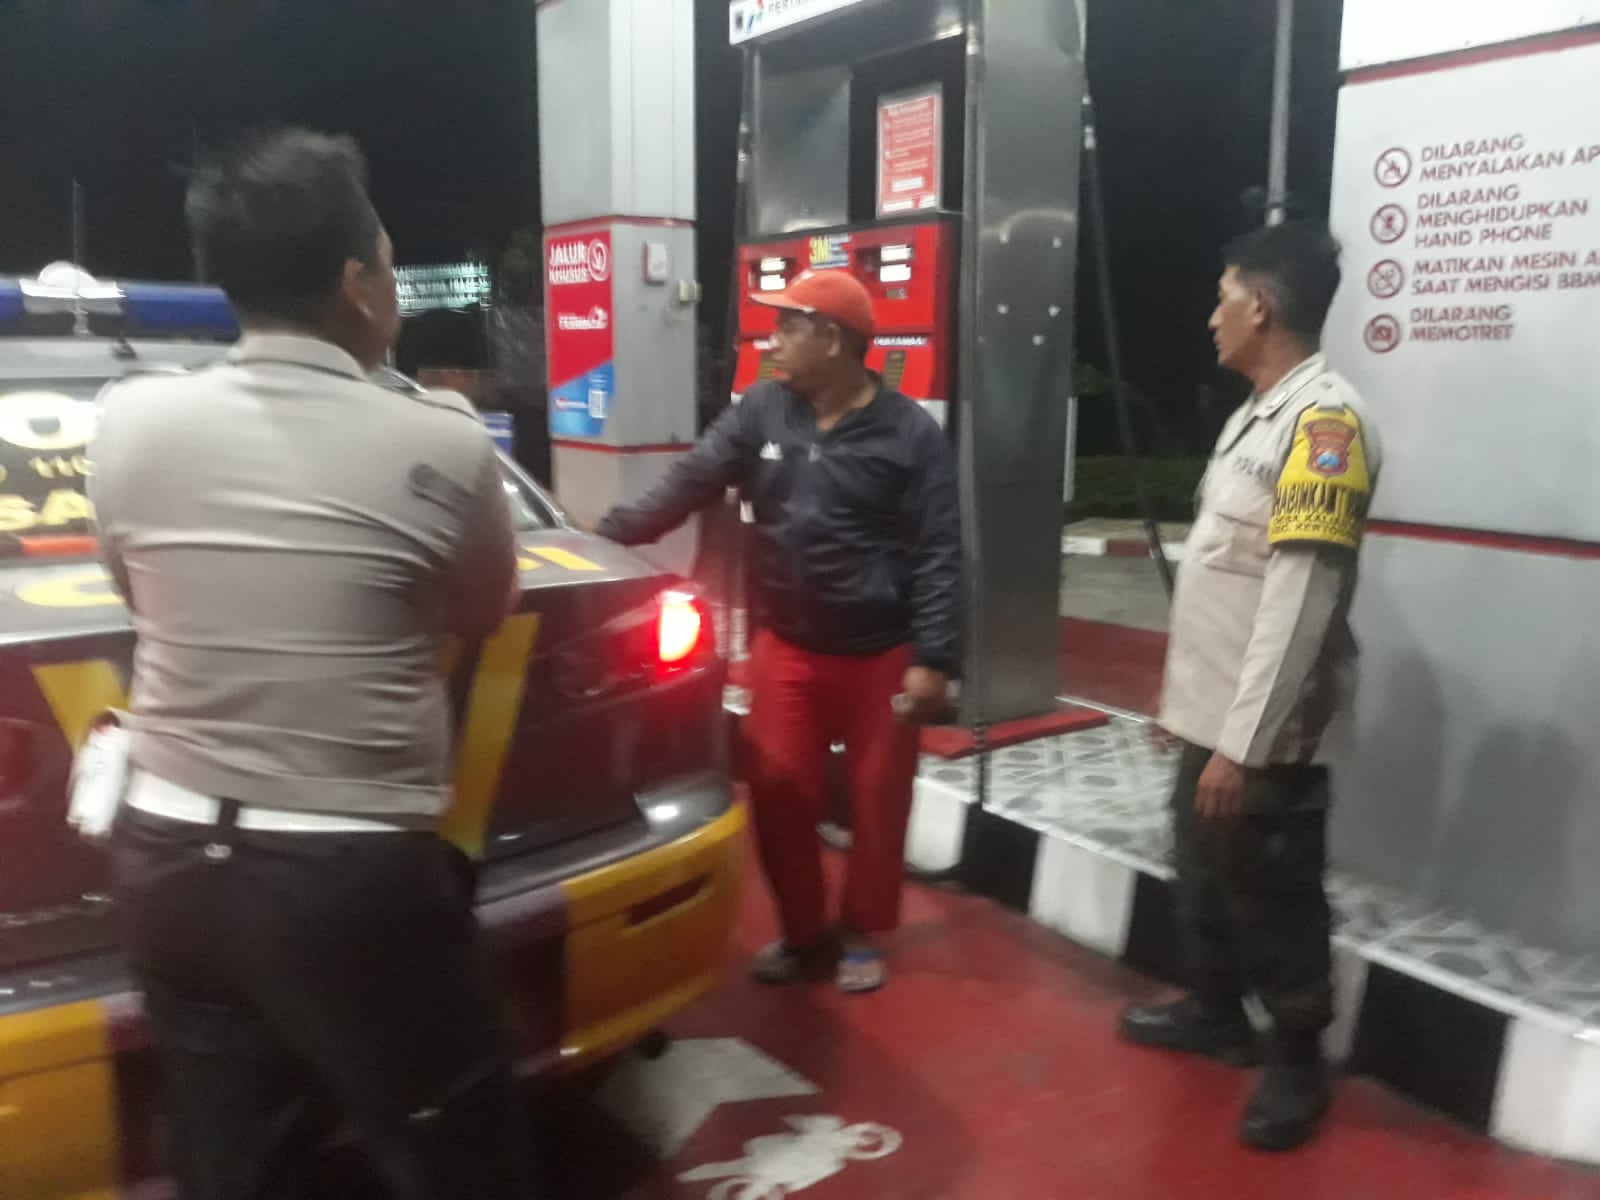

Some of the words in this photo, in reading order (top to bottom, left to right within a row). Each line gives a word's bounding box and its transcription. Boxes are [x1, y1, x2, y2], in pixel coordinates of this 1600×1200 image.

[1421, 133, 1525, 162] DILARANG
[1419, 151, 1564, 182] MENYALAKAN
[1417, 184, 1520, 210] DILARANG
[1416, 199, 1588, 228] MENGHIDUPKAN
[1414, 230, 1473, 248] HAND
[1479, 223, 1553, 244] PHONE
[549, 241, 588, 265] JALUR
[1413, 256, 1505, 275] MATIKAN
[1511, 251, 1577, 270] MESIN
[1411, 277, 1460, 295] SAAT
[1464, 272, 1551, 293] MENGISI
[1410, 304, 1512, 323] DILARANG
[1408, 323, 1515, 342] MEMOTRET
